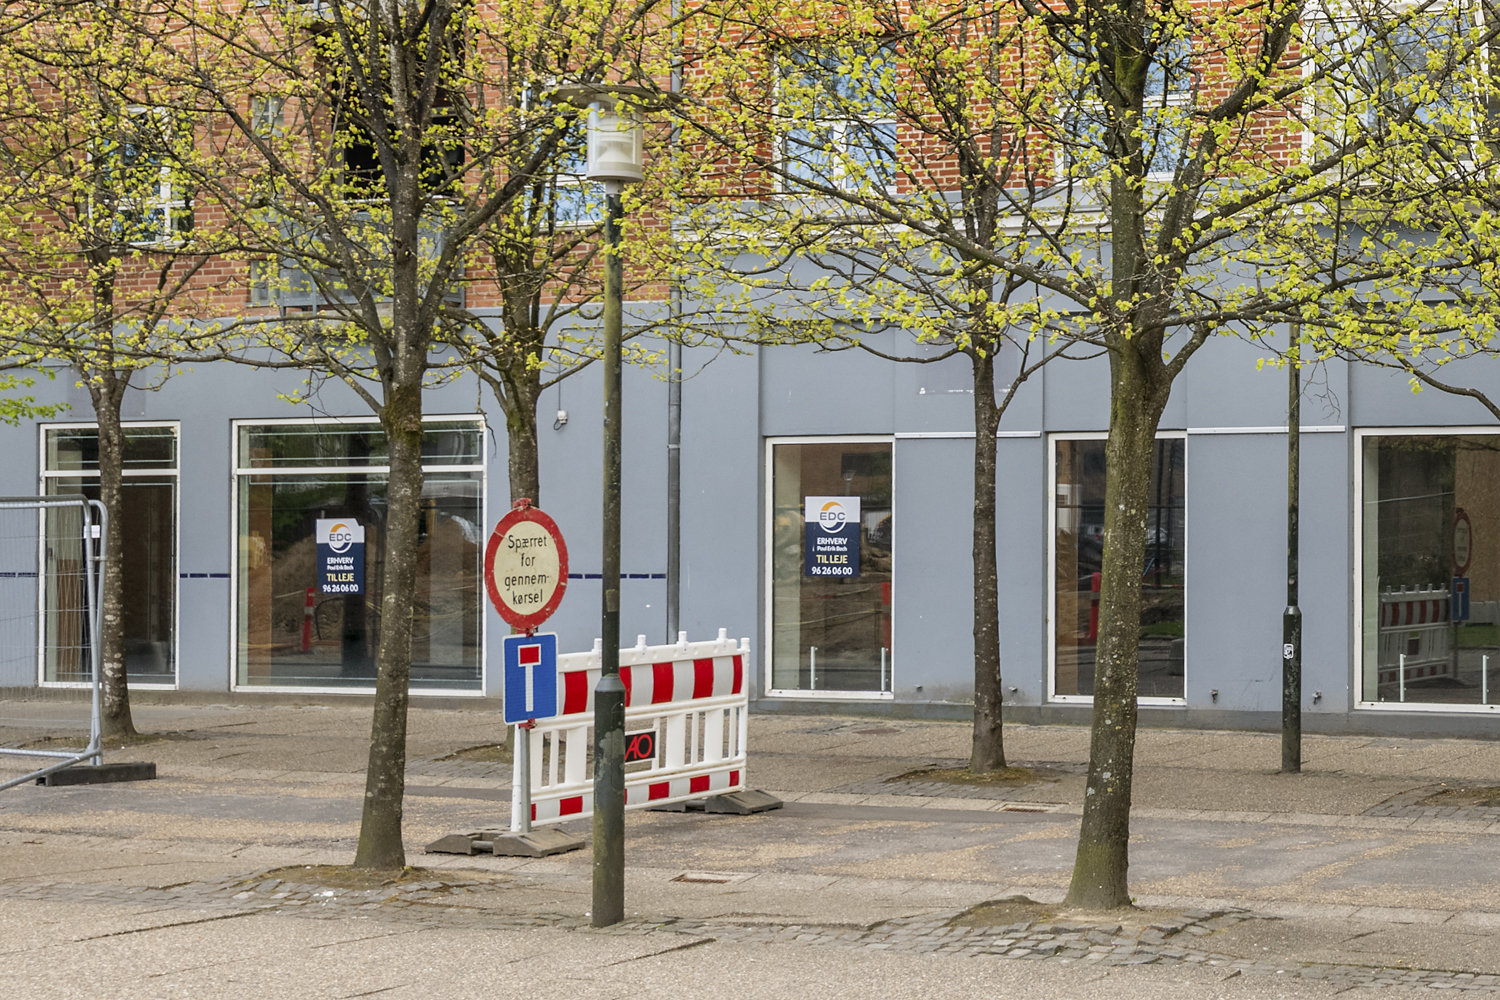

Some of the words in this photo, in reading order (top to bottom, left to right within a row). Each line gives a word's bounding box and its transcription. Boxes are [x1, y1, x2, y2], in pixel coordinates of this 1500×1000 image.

[820, 512, 846, 521] EDC
[329, 533, 352, 541] EDC
[817, 537, 848, 545] ERHVERV
[508, 534, 547, 553] Spærret
[520, 552, 536, 567] for
[816, 554, 829, 564] TIL
[829, 554, 848, 564] LEJE
[811, 566, 821, 575] 96
[822, 566, 832, 575] 26
[832, 566, 842, 575] 06
[842, 566, 853, 575] 00
[326, 573, 338, 582] TIL
[338, 573, 355, 582] LEJE
[504, 574, 550, 591] gennem-
[322, 584, 331, 593] 96
[331, 584, 340, 593] 26
[340, 584, 349, 593] 06
[349, 584, 359, 593] 00
[512, 589, 543, 605] kørsel
[625, 734, 653, 761] AO
